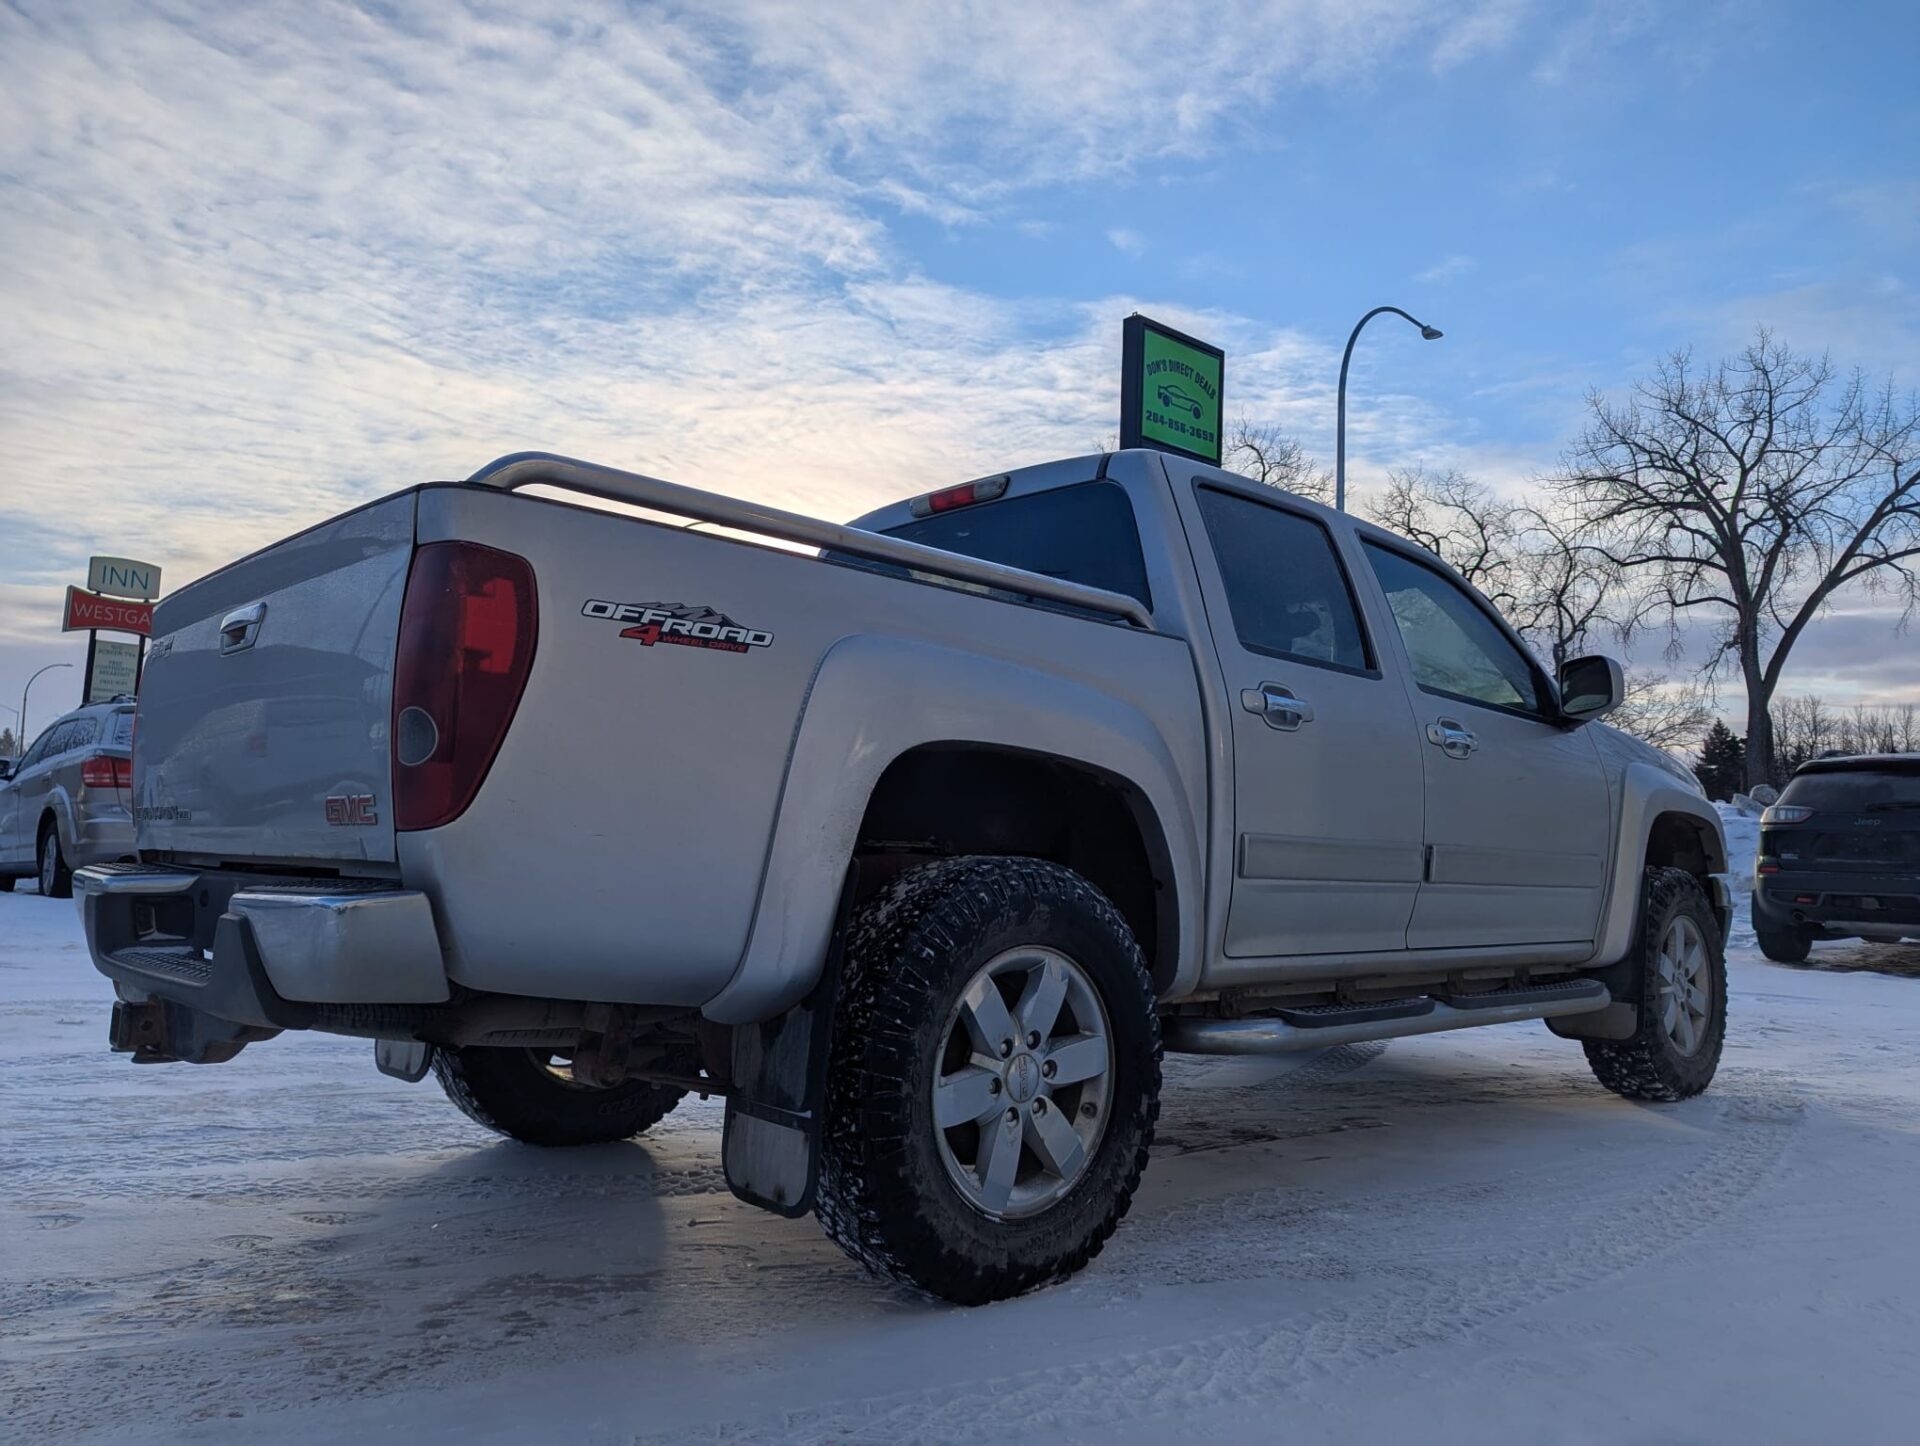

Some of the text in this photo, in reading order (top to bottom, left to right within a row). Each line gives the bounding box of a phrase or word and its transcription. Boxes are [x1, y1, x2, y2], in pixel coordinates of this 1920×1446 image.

[1168, 359, 1194, 380] DIRECT
[1194, 372, 1217, 400] DEALS
[102, 565, 149, 590] INN
[74, 602, 150, 625] WESTGA
[619, 624, 748, 653] 4 WHEEL DRIVE
[326, 794, 378, 826] GMC
[1854, 816, 1881, 827] Jeep
